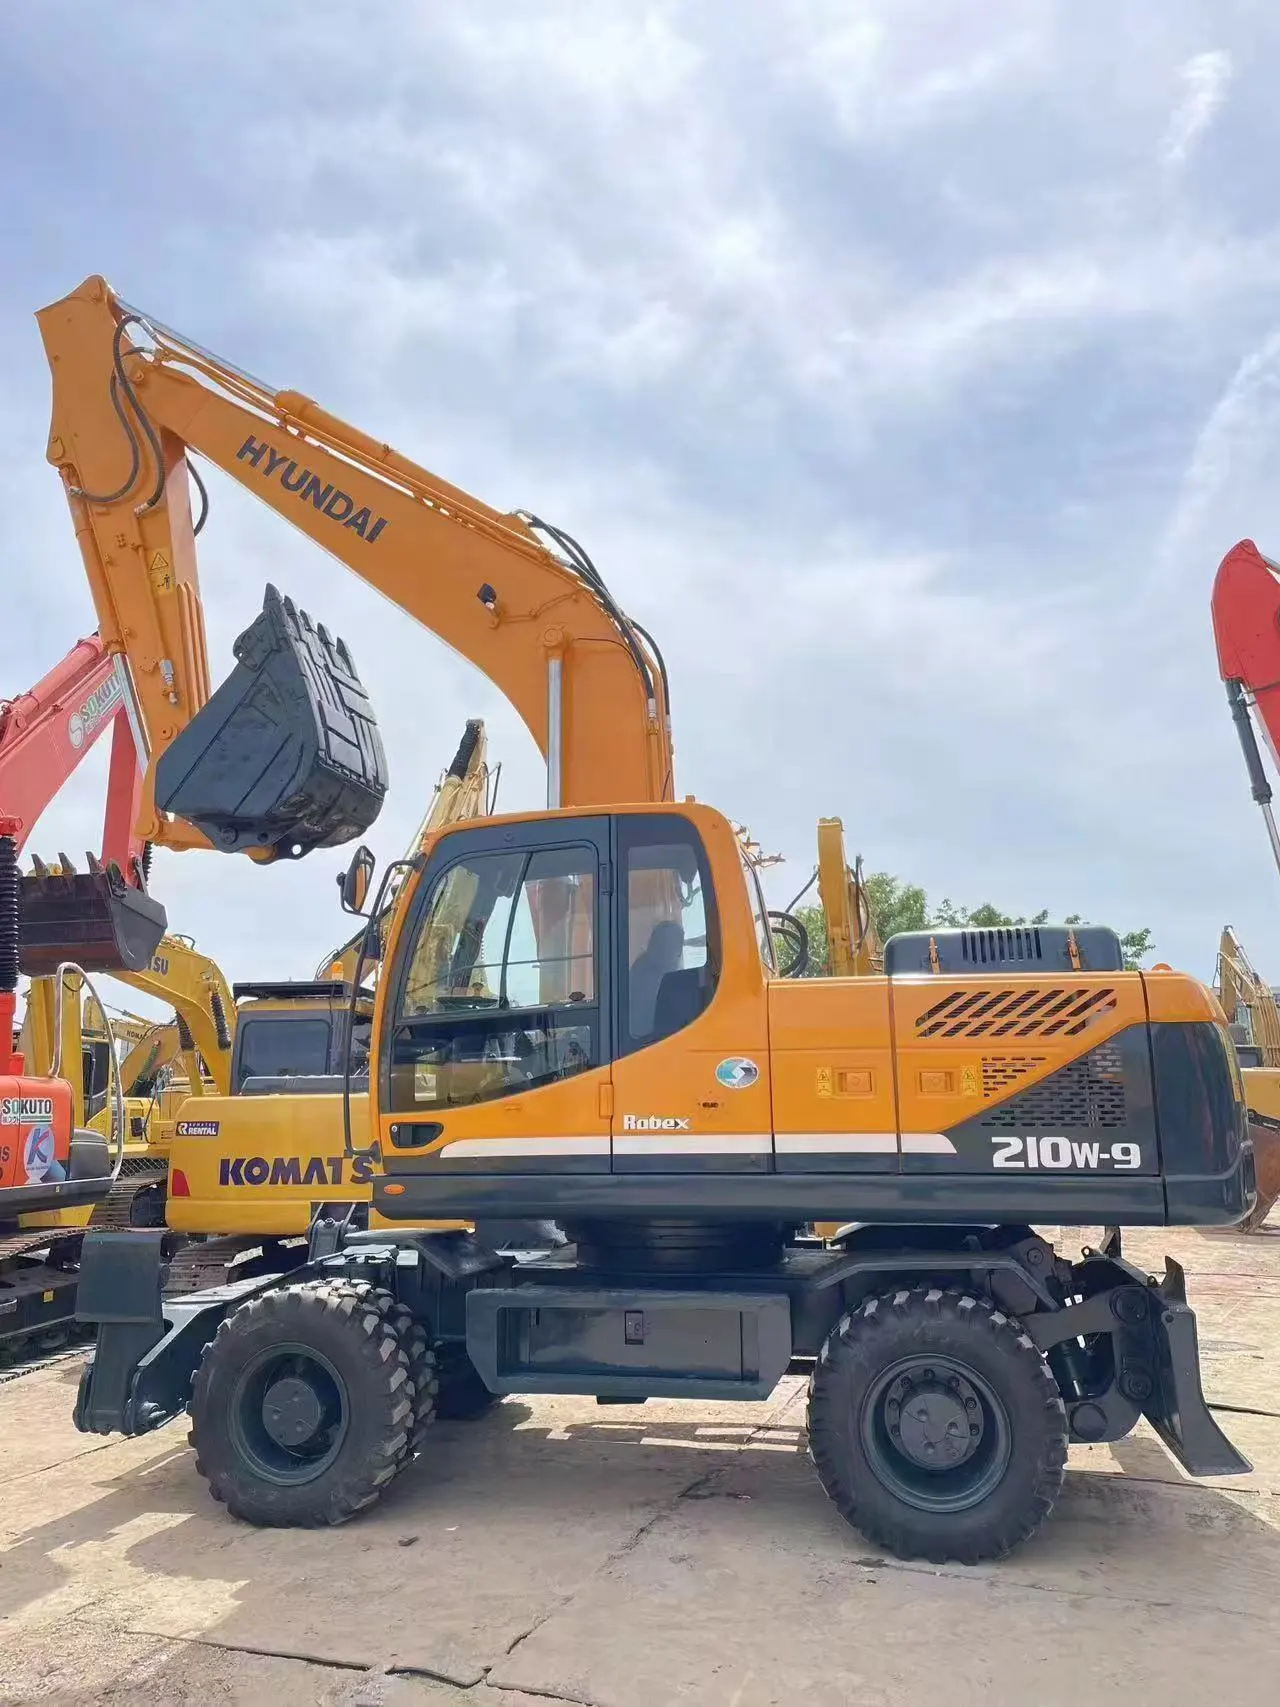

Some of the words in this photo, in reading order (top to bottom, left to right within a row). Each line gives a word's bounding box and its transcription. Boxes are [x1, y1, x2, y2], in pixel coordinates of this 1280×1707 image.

[236, 435, 389, 544] HYUNDAI
[80, 672, 120, 723] SOKUT
[2, 1099, 52, 1114] SOKUTO
[188, 1127, 217, 1135] RENTAL
[623, 1114, 690, 1130] Robex
[991, 1136, 1141, 1169] 210W-9
[219, 1157, 374, 1185] KOMATS
